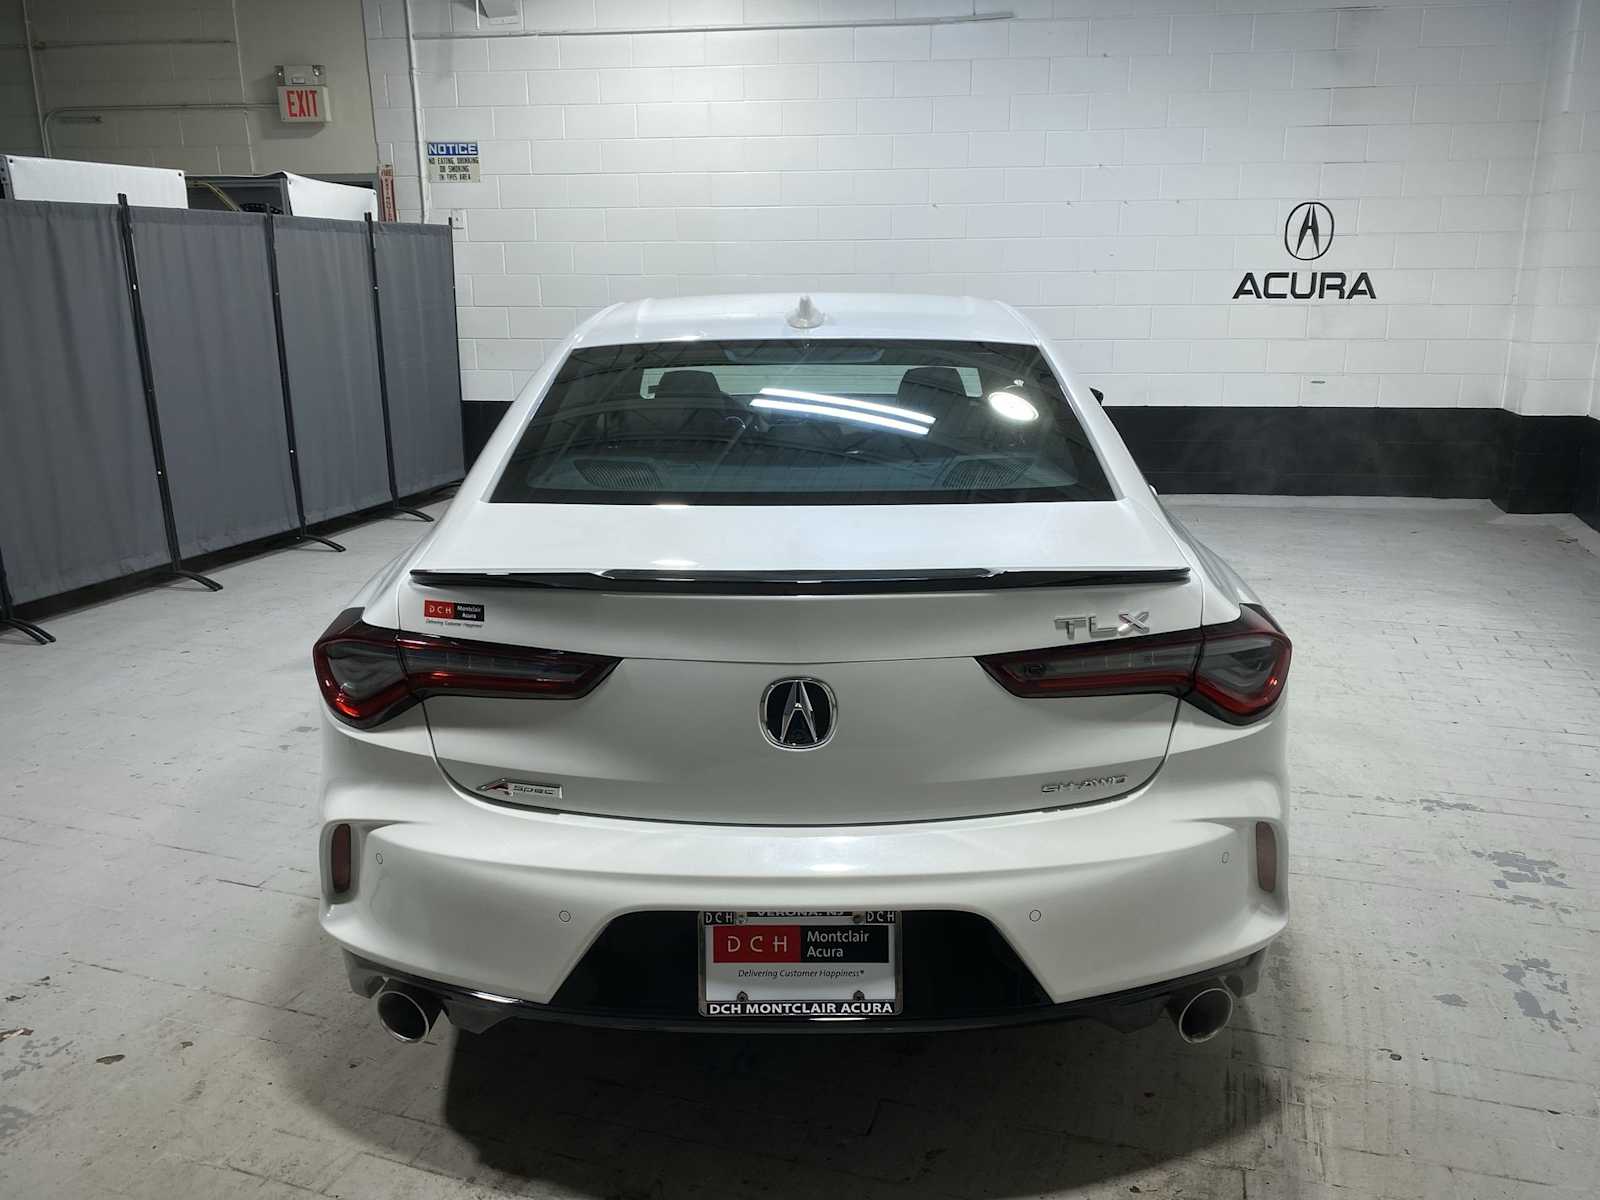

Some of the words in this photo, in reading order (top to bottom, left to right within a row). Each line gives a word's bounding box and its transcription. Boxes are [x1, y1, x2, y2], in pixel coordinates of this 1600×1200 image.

[287, 90, 318, 117] EXIT
[428, 143, 478, 155] NOTICE
[1232, 272, 1376, 299] ACURA
[1054, 612, 1150, 640] TLX
[806, 930, 870, 943] Montclair
[806, 946, 844, 958] Acura
[738, 969, 778, 979] Delivering
[779, 969, 817, 978] Customer
[709, 1003, 741, 1014] DCH
[745, 1003, 836, 1014] MONTCLAIR
[840, 1002, 893, 1014] ACURA
